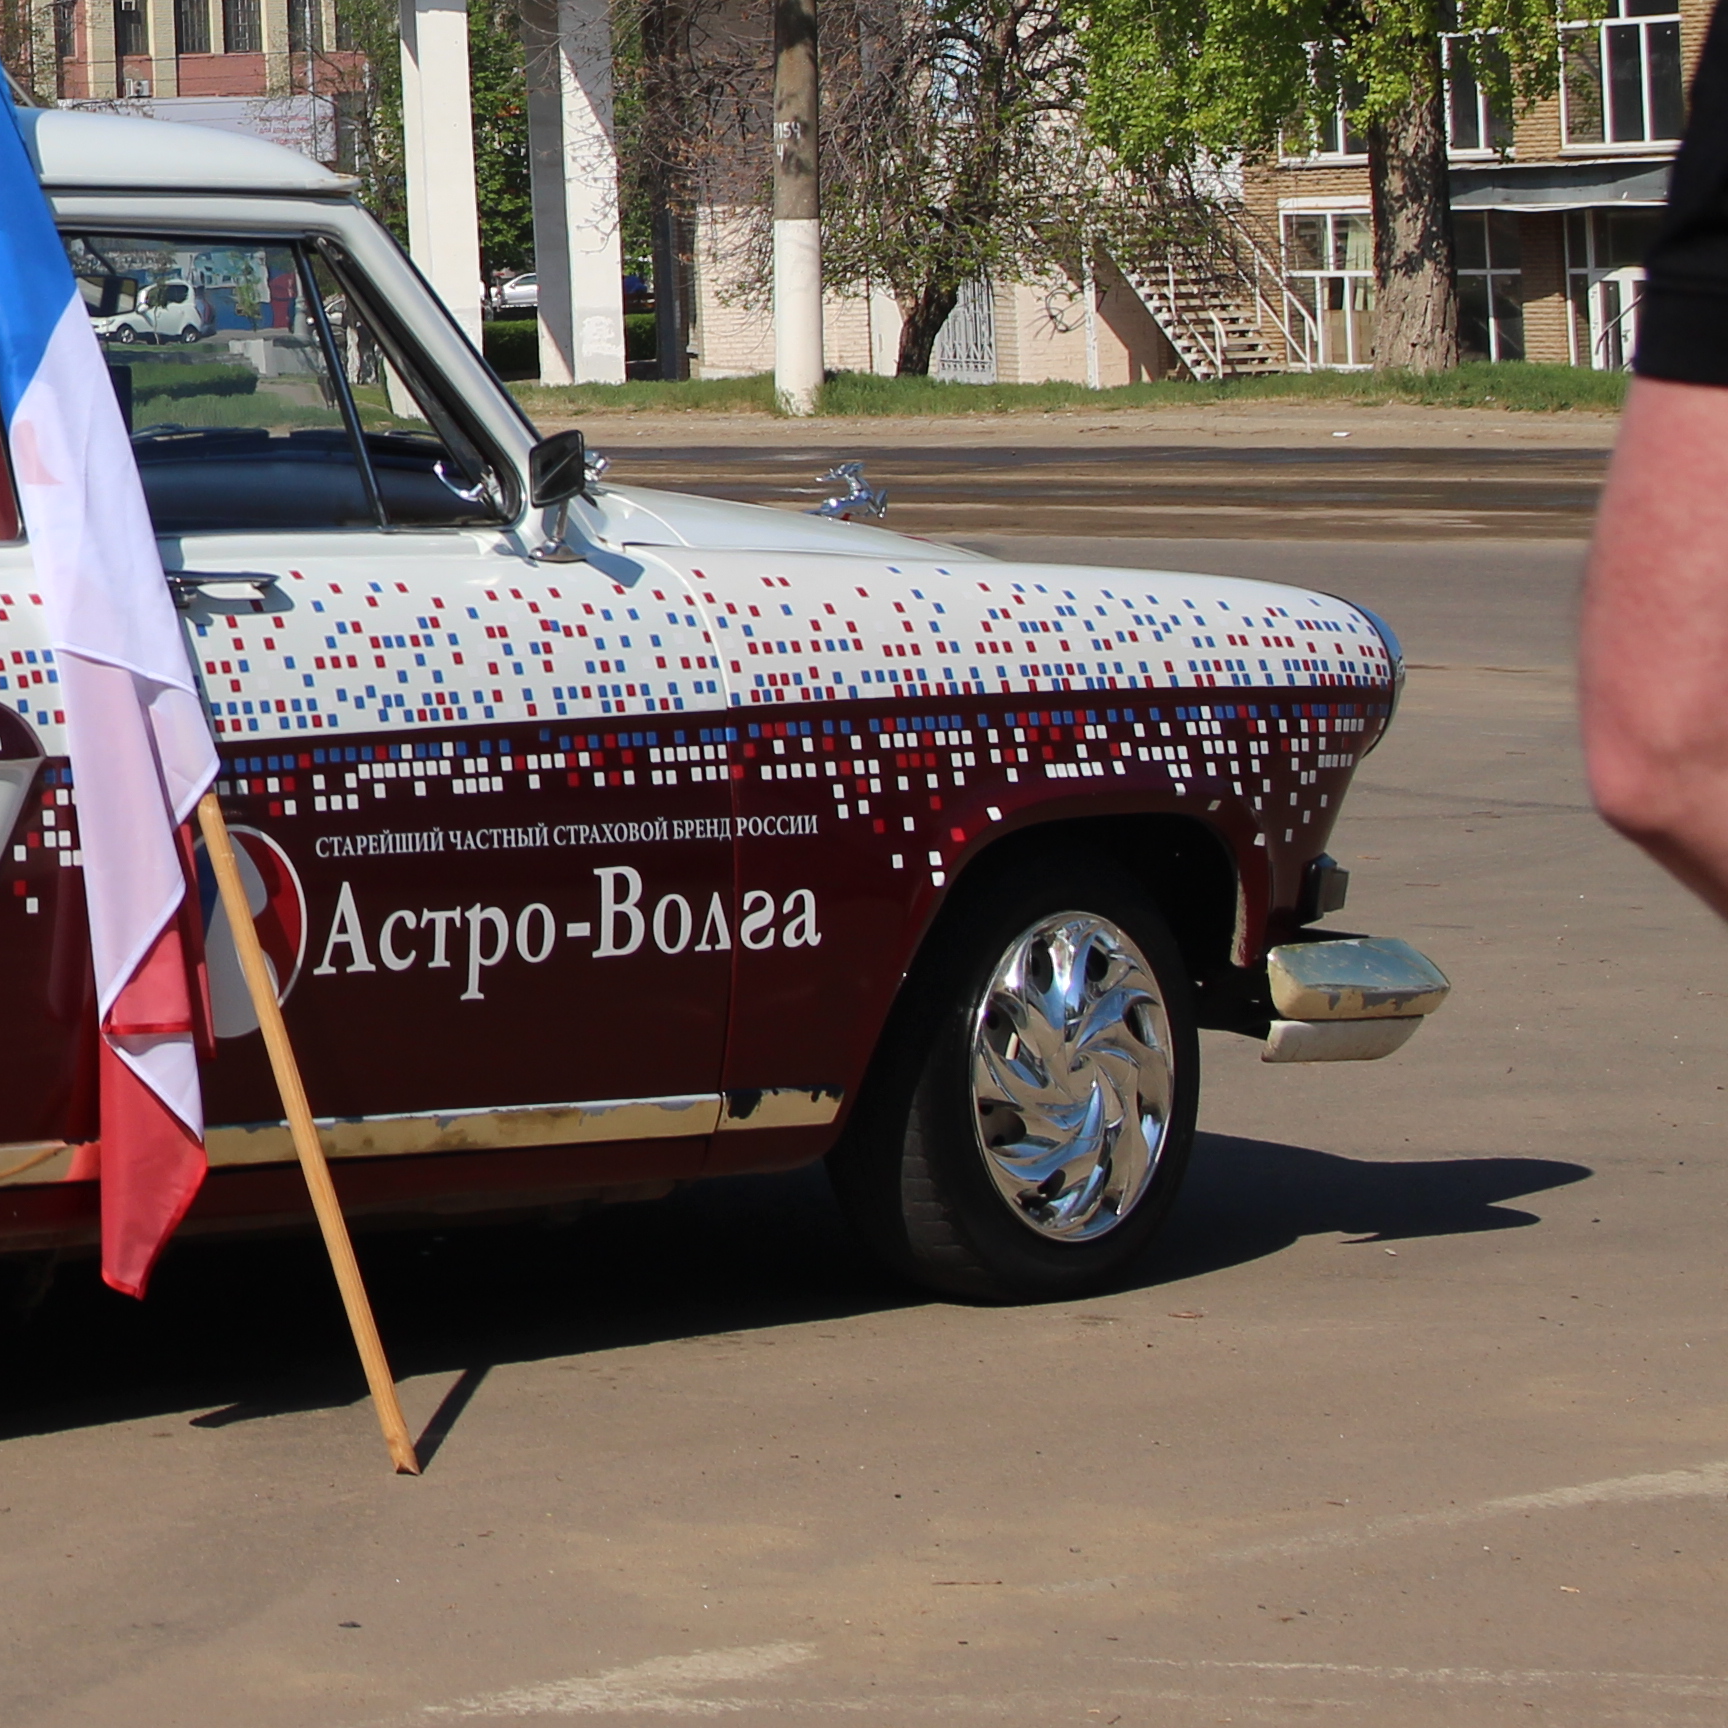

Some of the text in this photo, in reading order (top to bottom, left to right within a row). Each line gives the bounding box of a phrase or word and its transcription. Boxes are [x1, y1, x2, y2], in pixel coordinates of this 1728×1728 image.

[315, 815, 819, 858] СТАРЕЙШИЙ ЧАСТНЫЙ СТРАХОВОЙ БРЕНД РОССИИ
[312, 864, 822, 1001] Астро-Волга
